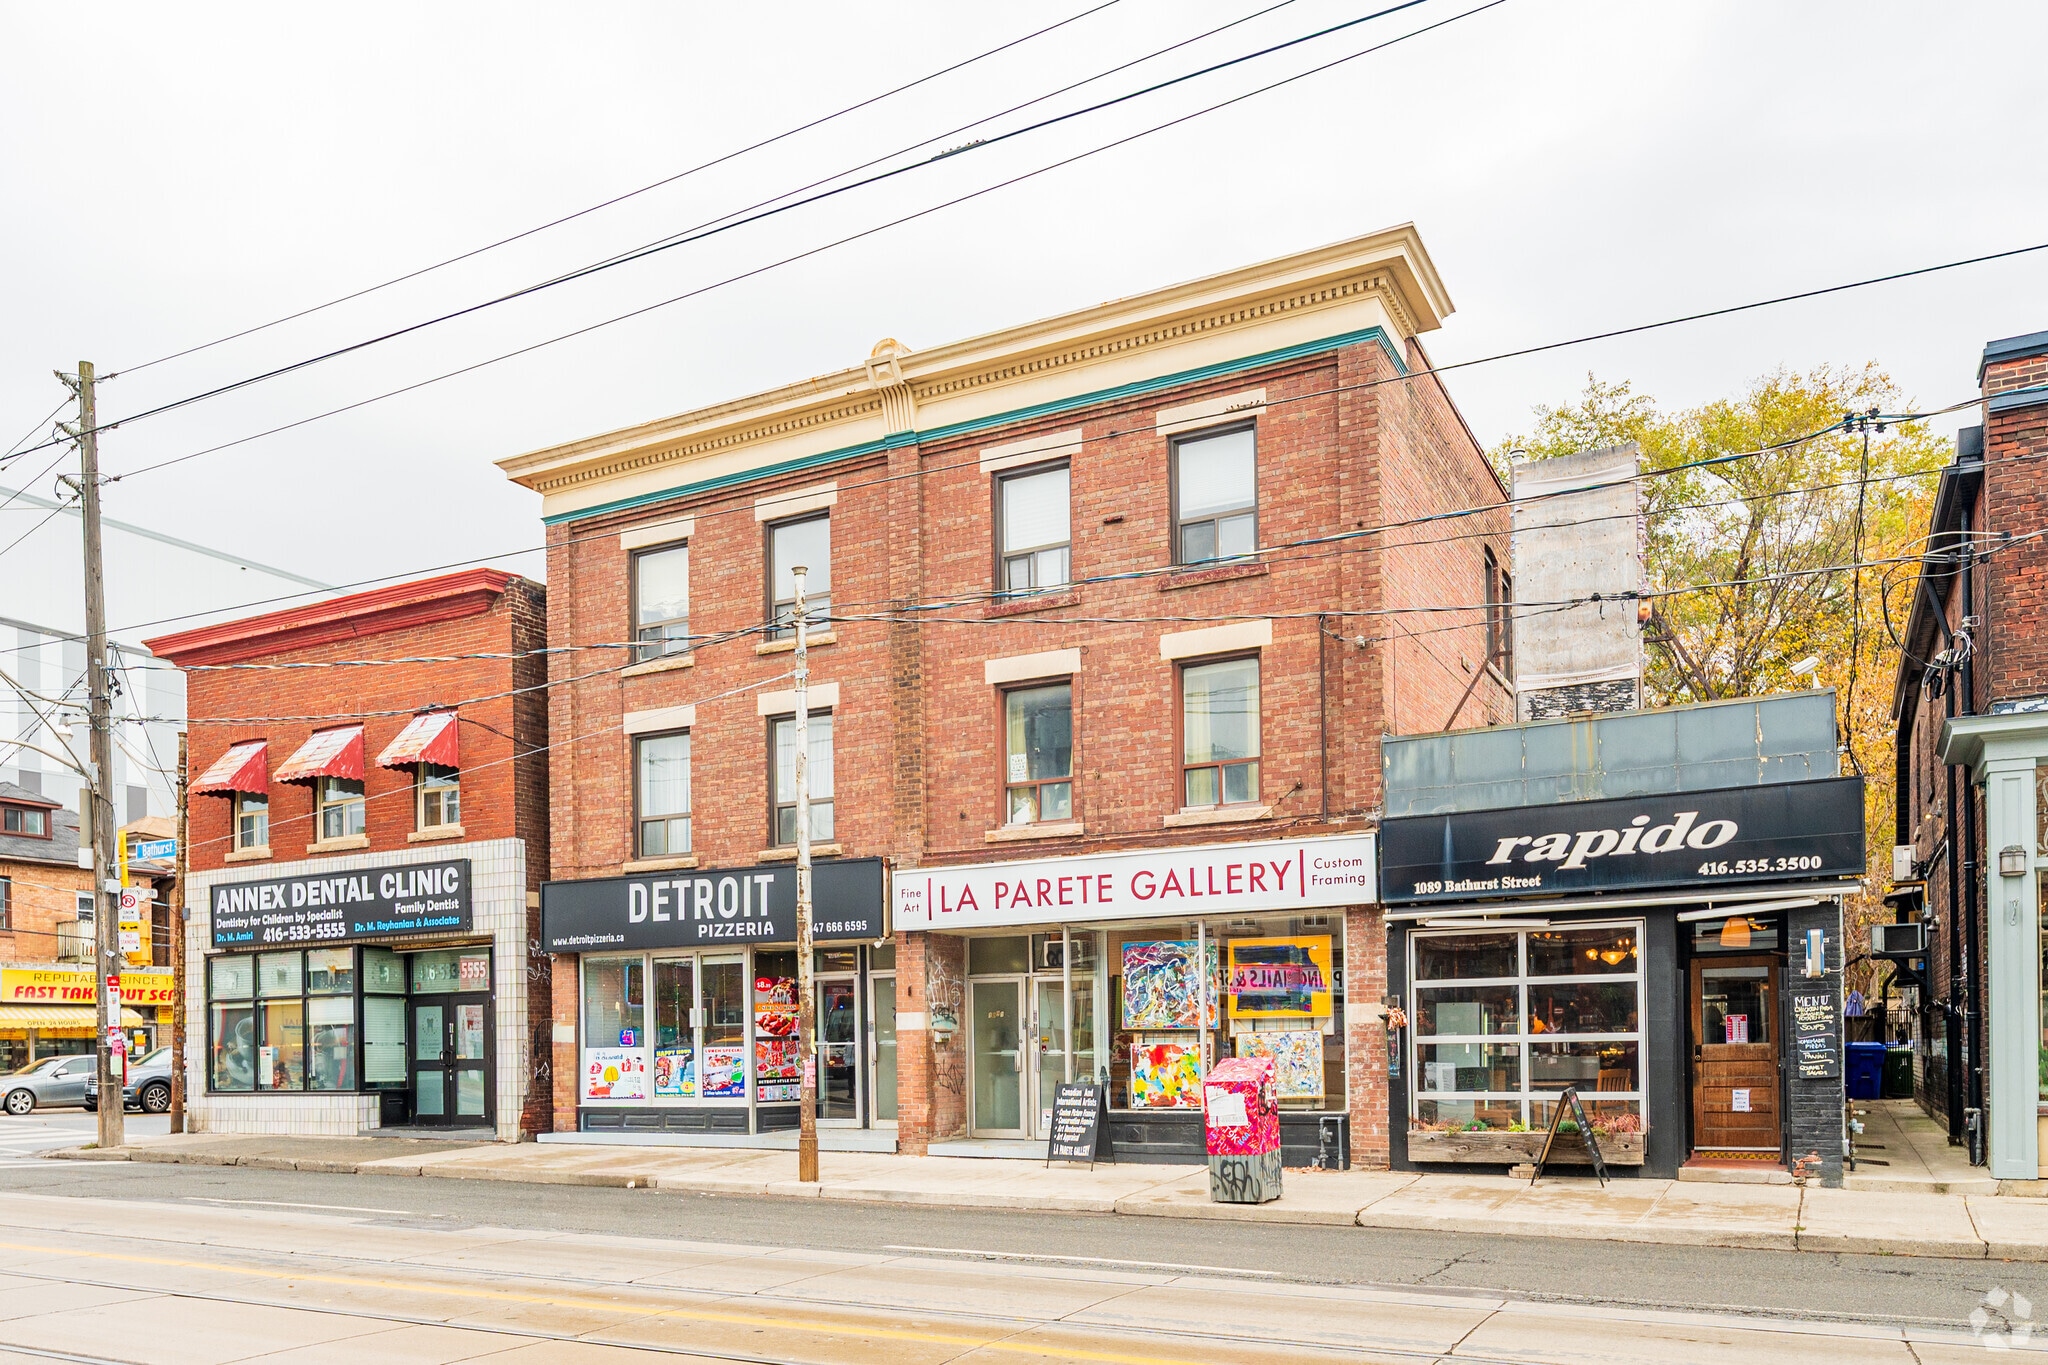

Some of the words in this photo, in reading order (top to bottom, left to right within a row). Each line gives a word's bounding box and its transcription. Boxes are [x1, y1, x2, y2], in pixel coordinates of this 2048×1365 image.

[1486, 811, 1738, 870] rapido
[142, 843, 173, 857] Bathurst
[1314, 857, 1362, 869] Custom
[1698, 856, 1822, 876] 416.535.3500
[941, 883, 978, 912] LA
[994, 874, 1113, 910] PARETE
[1130, 860, 1292, 900] GALLERY
[1312, 874, 1366, 886] Framing
[1414, 881, 1442, 894] 1089
[1445, 877, 1498, 892] Bathurst
[1502, 876, 1541, 888] Street
[216, 884, 286, 914] ANNEX
[292, 876, 374, 907] DENTAL
[380, 866, 458, 899] CLINIC
[901, 888, 922, 898] Fine
[629, 874, 774, 923] DETROIT
[394, 901, 426, 914] Family
[427, 898, 459, 912] Dentist
[904, 904, 920, 912] Art
[216, 916, 248, 928] Dentistry
[250, 916, 260, 926] for
[262, 912, 294, 925] Children
[296, 912, 305, 924] by
[307, 909, 343, 922] Specialist
[354, 922, 366, 932] Dr.
[367, 922, 376, 931] M.
[377, 920, 414, 932] Reyhanian
[416, 918, 422, 927] &
[424, 916, 460, 926] Associates
[263, 922, 346, 942] 416-533-5555
[698, 921, 774, 938] PIZZERIA
[810, 922, 823, 933] 47
[826, 921, 842, 932] 666
[845, 920, 868, 932] 6595
[216, 932, 226, 942] Dr.
[227, 932, 235, 940] M.
[236, 931, 254, 940] Amiri
[552, 933, 624, 946] www.detroitpizzeria.ca
[34, 973, 97, 983] REPUTAB
[120, 976, 158, 986] SINCE
[14, 986, 57, 998] FAST
[61, 986, 97, 1000] TAK
[149, 989, 174, 1001] SER
[1794, 995, 1830, 1006] MENU
[1062, 1088, 1082, 1096] Canadian
[1084, 1088, 1094, 1097] And
[1057, 1097, 1082, 1106] International
[1082, 1098, 1097, 1106] Artists
[1053, 1143, 1059, 1155] LA
[1059, 1144, 1073, 1156] PARETE
[1074, 1145, 1090, 1156] GALLERY
